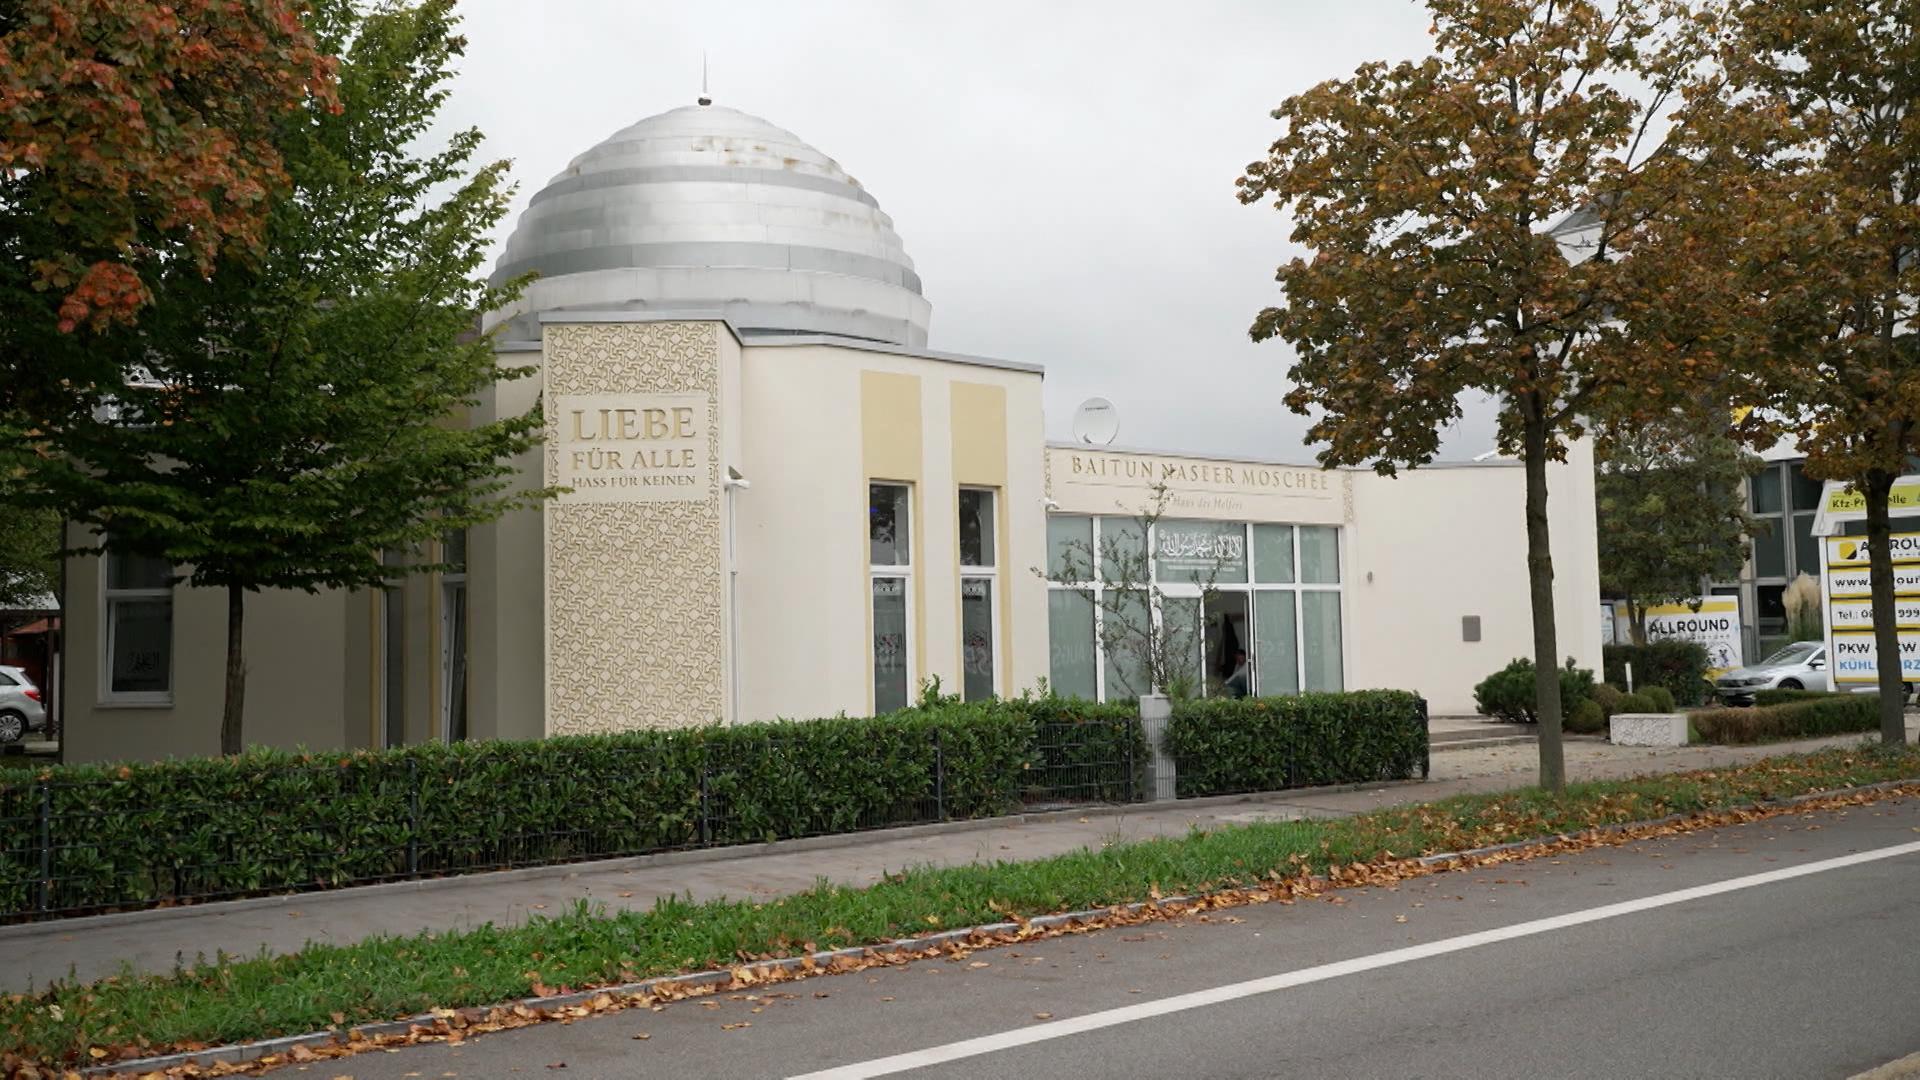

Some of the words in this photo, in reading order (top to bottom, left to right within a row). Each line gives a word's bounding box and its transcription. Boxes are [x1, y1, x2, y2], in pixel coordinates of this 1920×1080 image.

[570, 406, 697, 442] LIEBE
[571, 447, 624, 471] FÜR
[631, 449, 696, 470] ALLE
[572, 477, 607, 488] HASS
[643, 475, 696, 486] KEINEN
[1072, 455, 1153, 478] BAITUN
[1161, 463, 1235, 484] NASEER
[1242, 469, 1329, 491] MOSCHEE
[1648, 619, 1729, 634] ALLROUND
[1839, 643, 1870, 653] PKW
